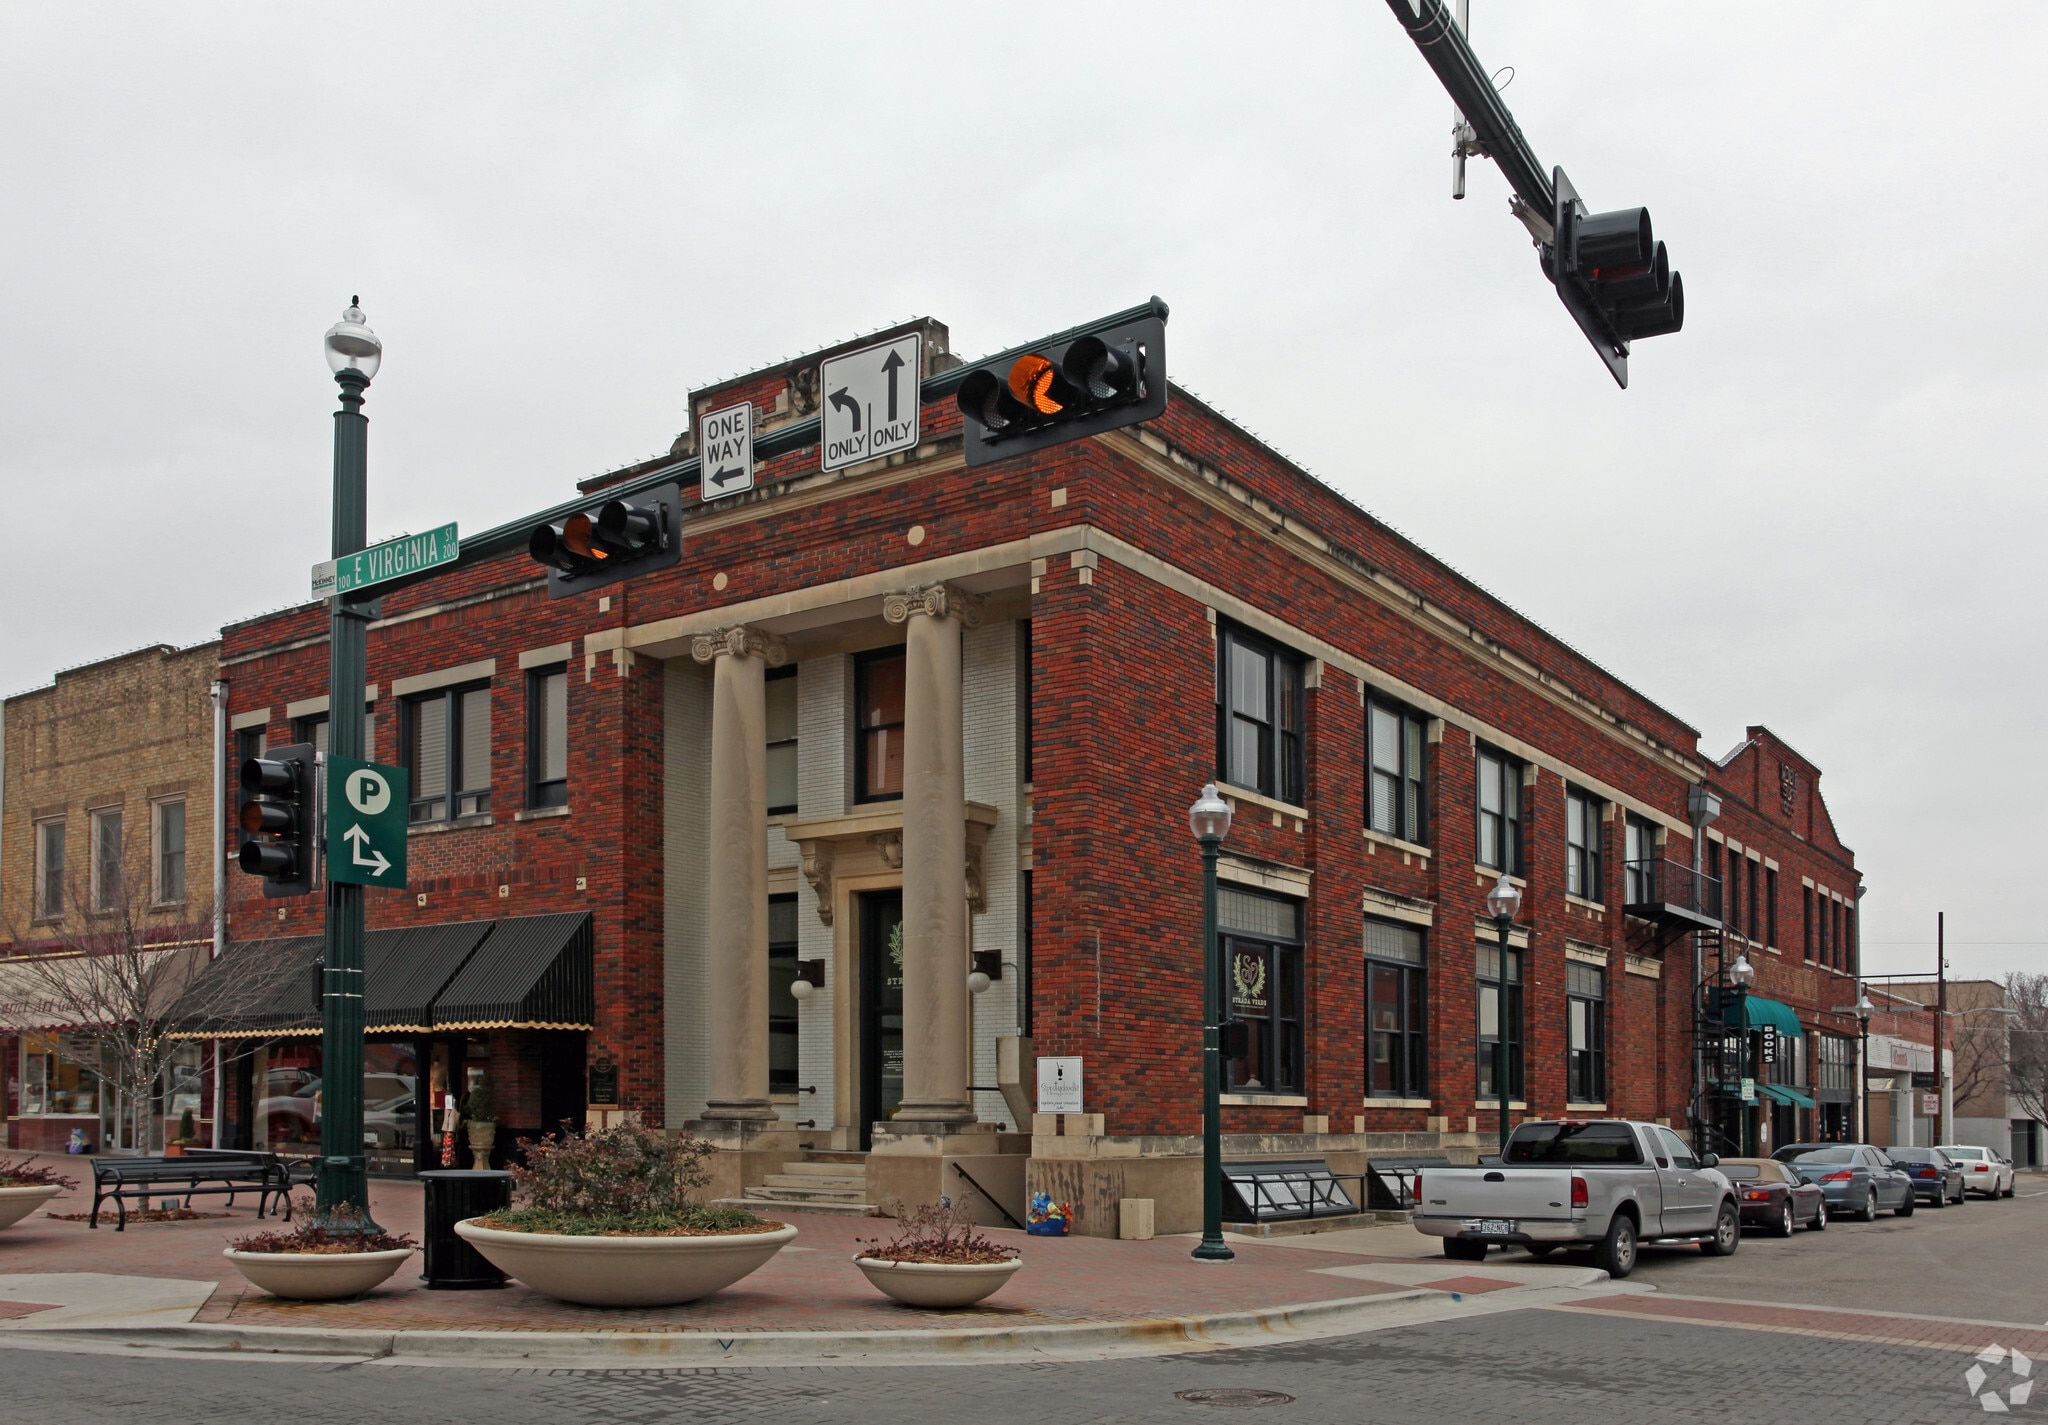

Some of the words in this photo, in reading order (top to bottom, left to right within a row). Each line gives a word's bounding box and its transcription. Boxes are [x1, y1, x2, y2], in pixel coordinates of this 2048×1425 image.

[708, 412, 744, 440] ONE
[873, 420, 913, 448] ONLY
[707, 435, 745, 464] WAY
[828, 434, 866, 460] ONLY
[354, 556, 362, 585] E
[368, 533, 438, 580] VIRGINIA
[445, 526, 453, 542] ST
[443, 542, 456, 559] 200
[338, 574, 350, 590] 100
[359, 776, 380, 805] P
[1764, 1026, 1774, 1063] BOOKS
